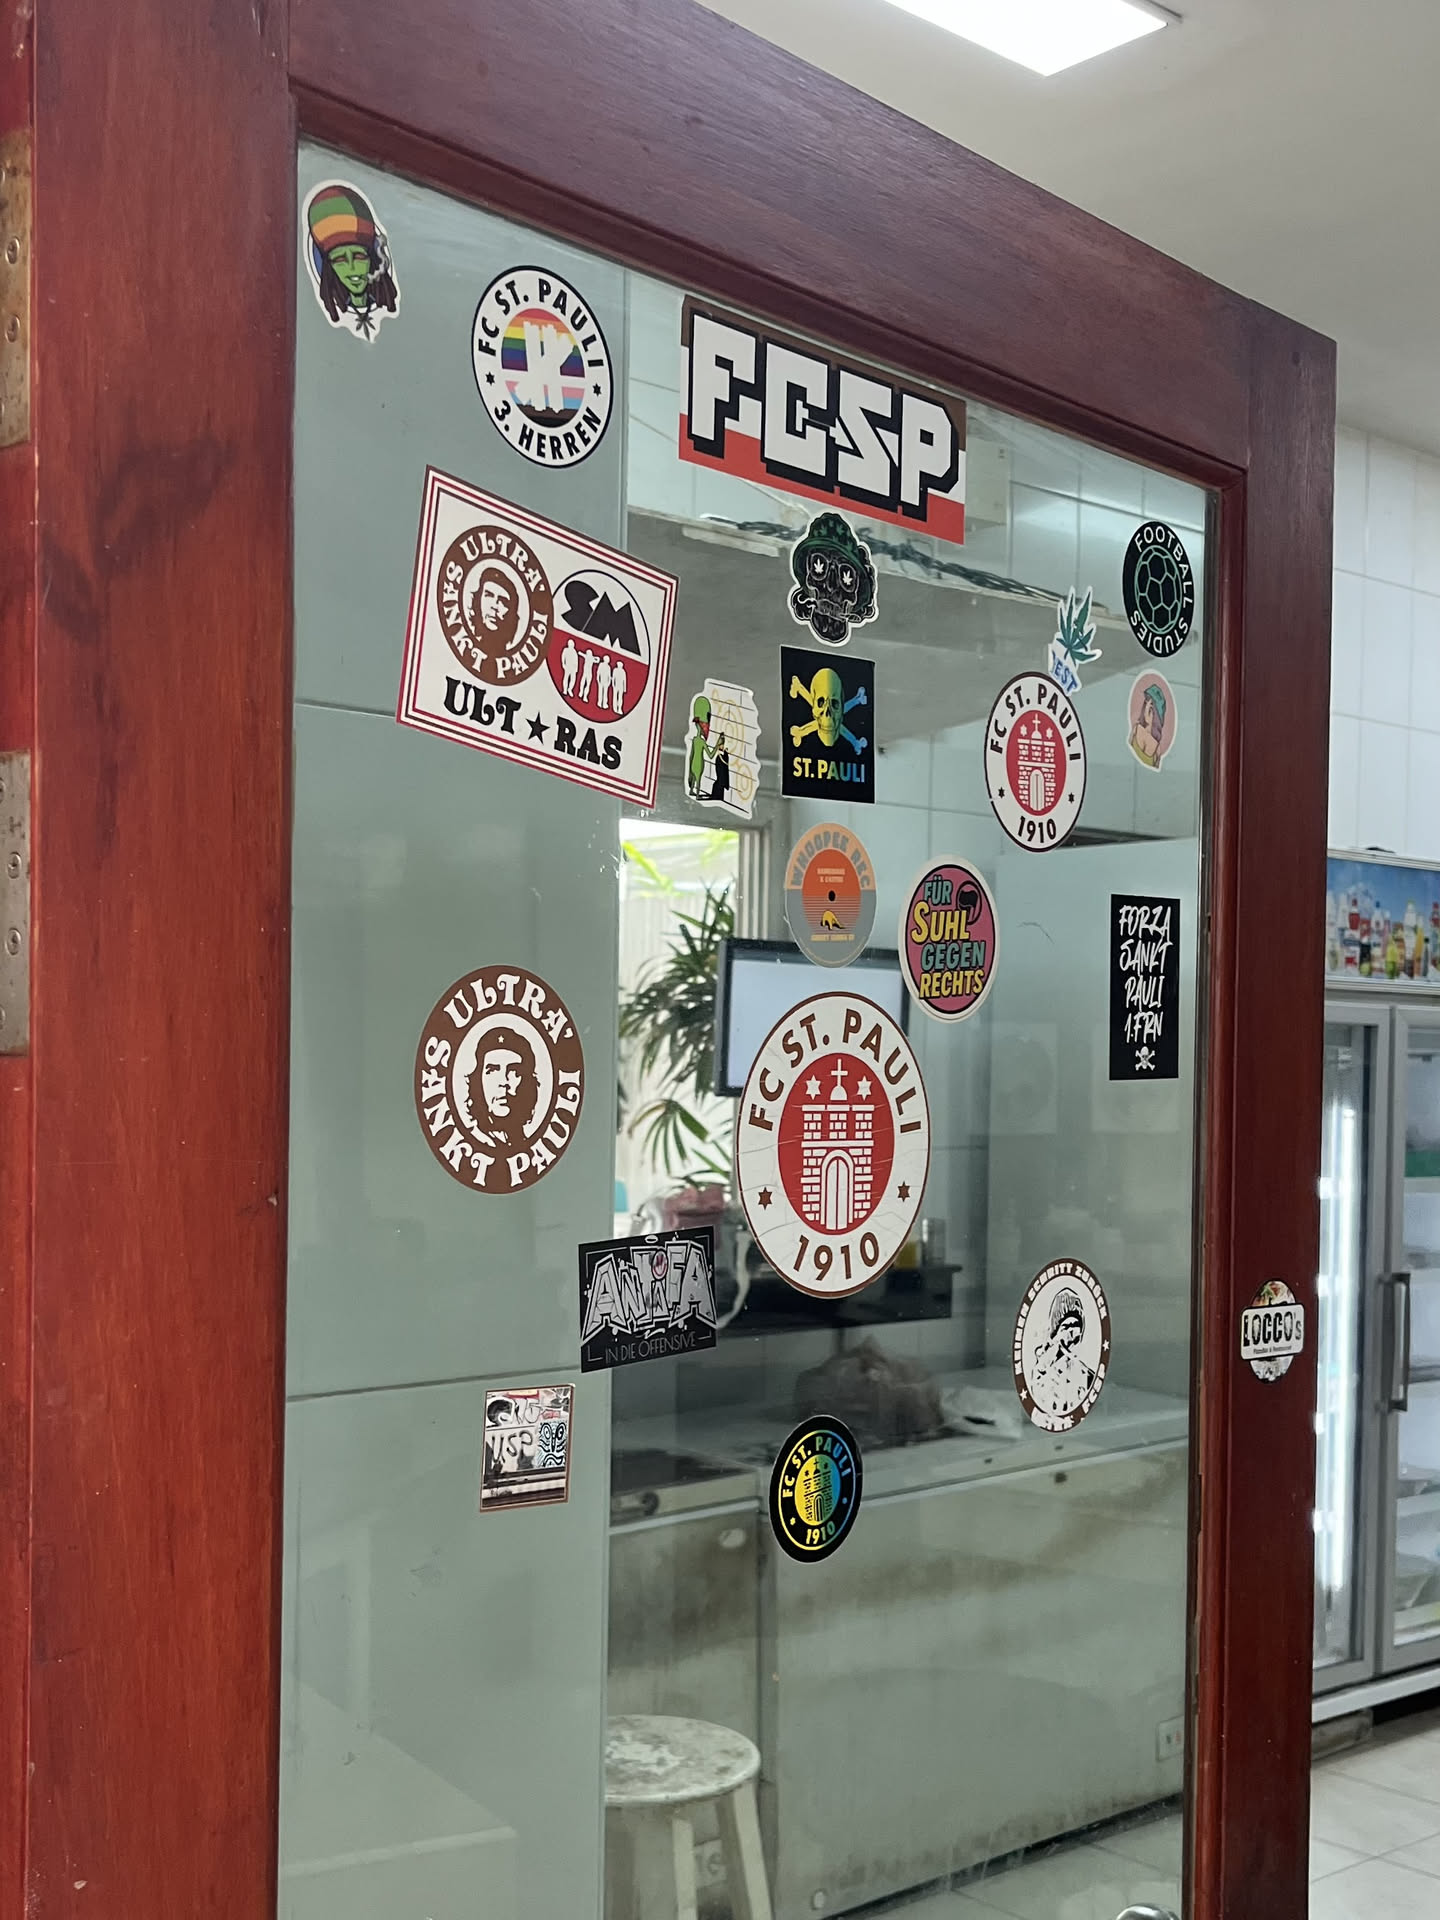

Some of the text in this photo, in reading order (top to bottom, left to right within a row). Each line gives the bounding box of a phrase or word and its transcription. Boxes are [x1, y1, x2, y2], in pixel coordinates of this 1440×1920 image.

[478, 278, 604, 368] FC ST. PAULI
[518, 407, 602, 461] HERREN
[689, 312, 957, 520] FCSP
[1131, 526, 1193, 654] FOOTBALL STUDIES
[443, 560, 549, 680] SANKT PAULI
[989, 683, 1081, 760] FC ST. PAULI
[793, 756, 865, 783] ST. PAULI
[1016, 814, 1057, 844] 1910
[923, 873, 954, 906] FÜR
[910, 901, 970, 944] SUHL
[1118, 904, 1172, 943] FORZA
[921, 941, 986, 972] GEGEN
[1119, 939, 1174, 977] SANKT
[918, 969, 986, 1000] RECHTS
[1124, 974, 1165, 1013] PAULI
[748, 1008, 922, 1135] FC ST. PAULI
[421, 1035, 582, 1188] SANKT PAULI
[793, 1231, 880, 1282] 1910
[605, 1331, 697, 1364] IN DIE OFFENSIVE
[782, 1435, 852, 1498] FC ST. PAULI
[805, 1520, 836, 1545] 1910
